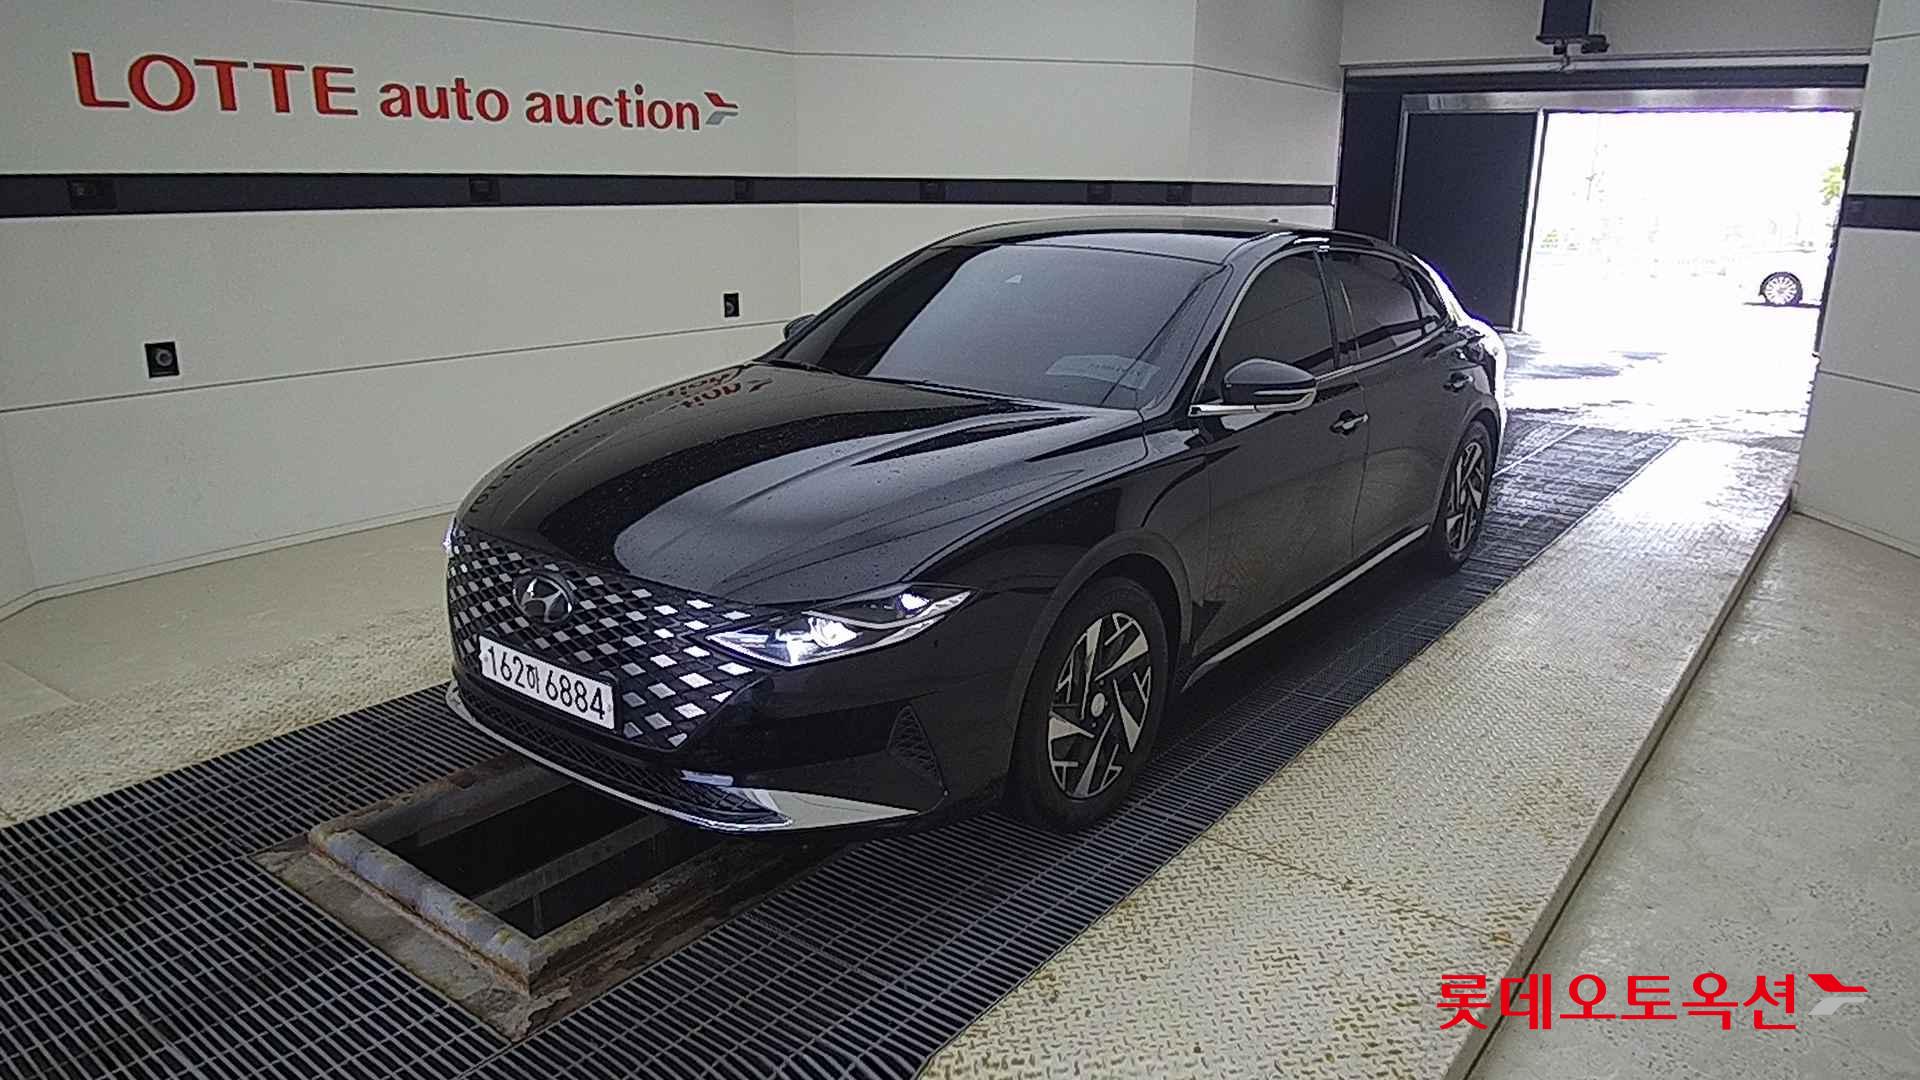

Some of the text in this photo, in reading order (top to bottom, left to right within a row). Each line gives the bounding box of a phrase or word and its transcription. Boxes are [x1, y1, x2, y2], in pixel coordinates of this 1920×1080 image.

[72, 52, 700, 130] LOTTE auto auction
[545, 670, 605, 720] 6884
